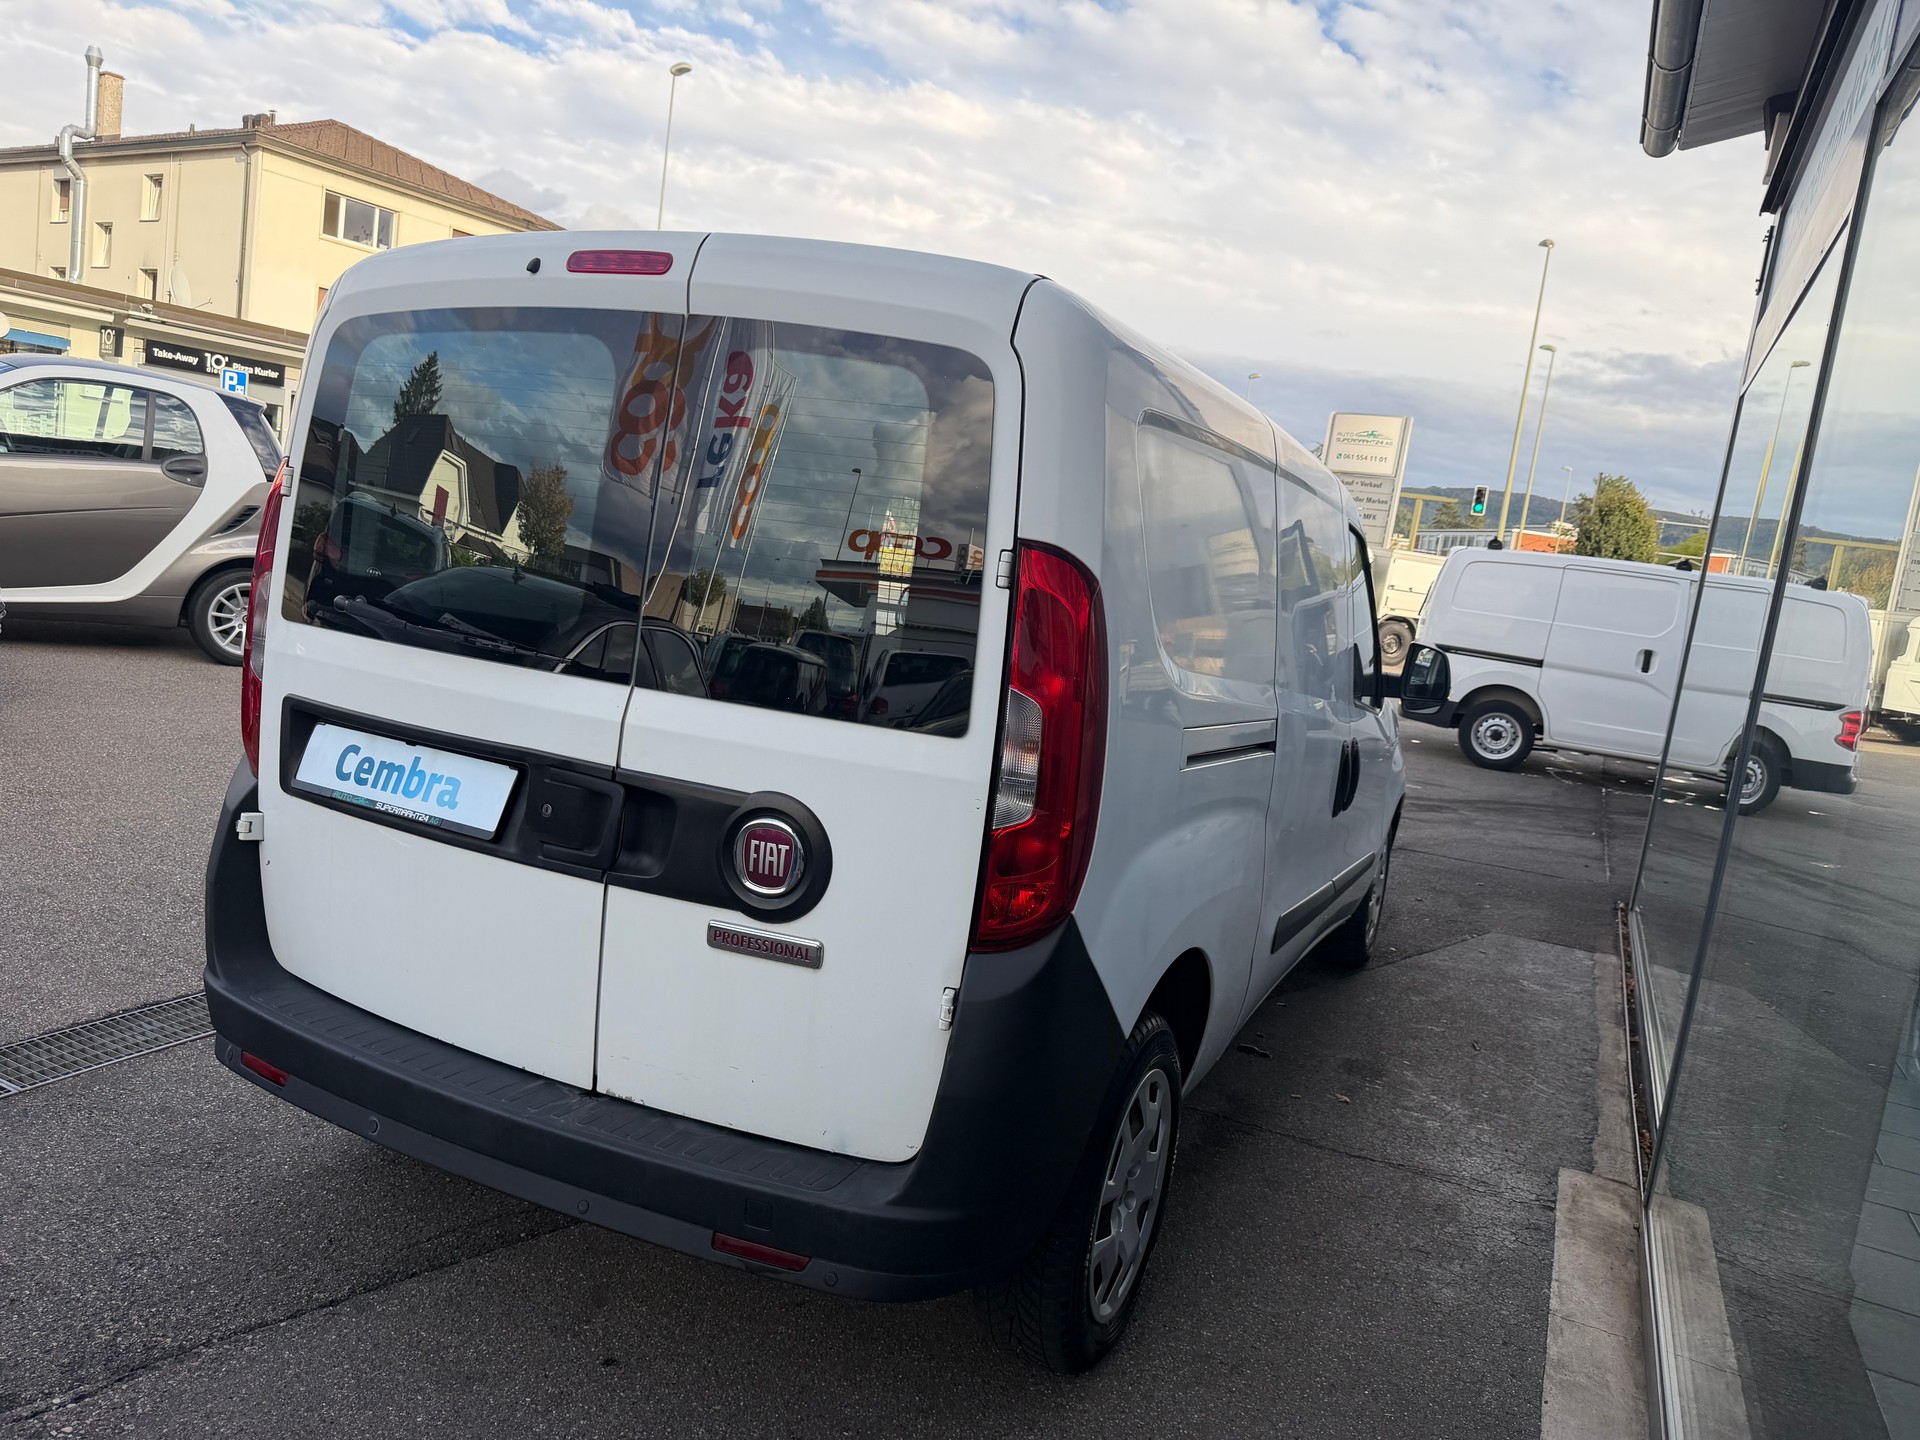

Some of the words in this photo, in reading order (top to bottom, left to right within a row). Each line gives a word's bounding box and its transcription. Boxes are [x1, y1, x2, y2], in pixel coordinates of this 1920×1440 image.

[152, 348, 199, 366] Take-Away
[232, 362, 254, 375] Pizza
[254, 366, 280, 379] Kurier
[225, 371, 238, 391] P
[1360, 480, 1383, 488] Verkauf
[1365, 497, 1388, 505] Marken
[335, 744, 462, 810] Cembra
[333, 790, 353, 801] AUTO
[748, 839, 790, 878] FIAT
[713, 929, 812, 963] PROFESSIONAL
